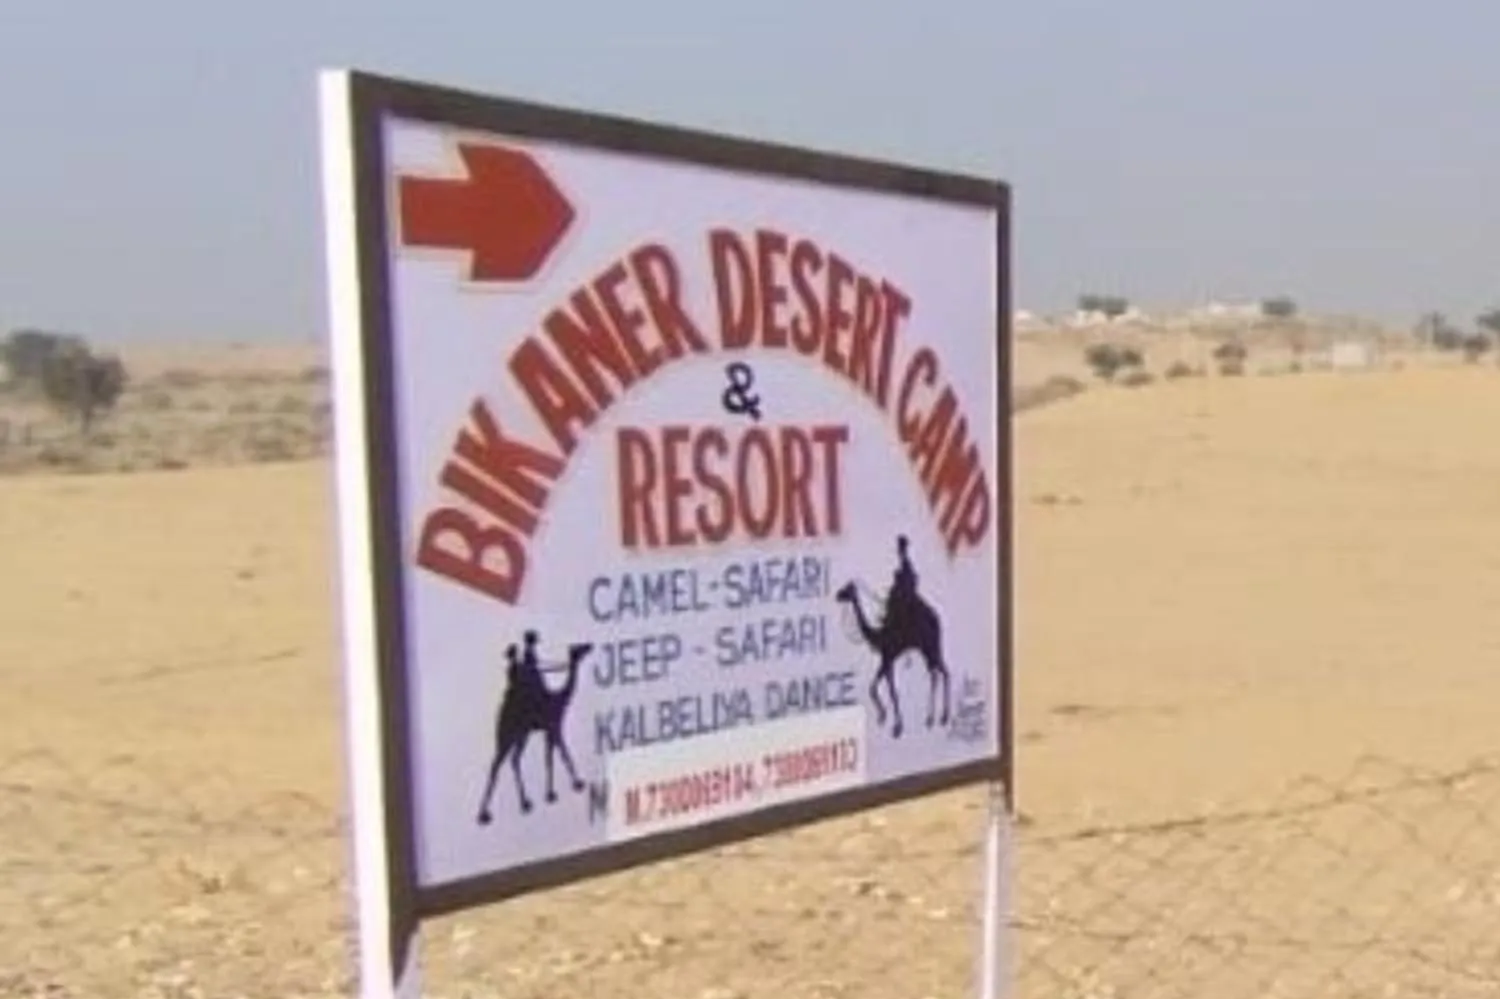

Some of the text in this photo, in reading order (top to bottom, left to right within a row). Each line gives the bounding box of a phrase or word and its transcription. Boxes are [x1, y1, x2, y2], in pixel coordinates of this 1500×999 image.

[709, 228, 912, 410] DESERT
[897, 345, 990, 560] CAMP
[721, 362, 761, 420] &
[617, 426, 849, 549] RESORT
[593, 633, 682, 688] JEEP
[715, 615, 827, 667] SAFARI
[594, 670, 856, 756] KALBELIYA DANCE
